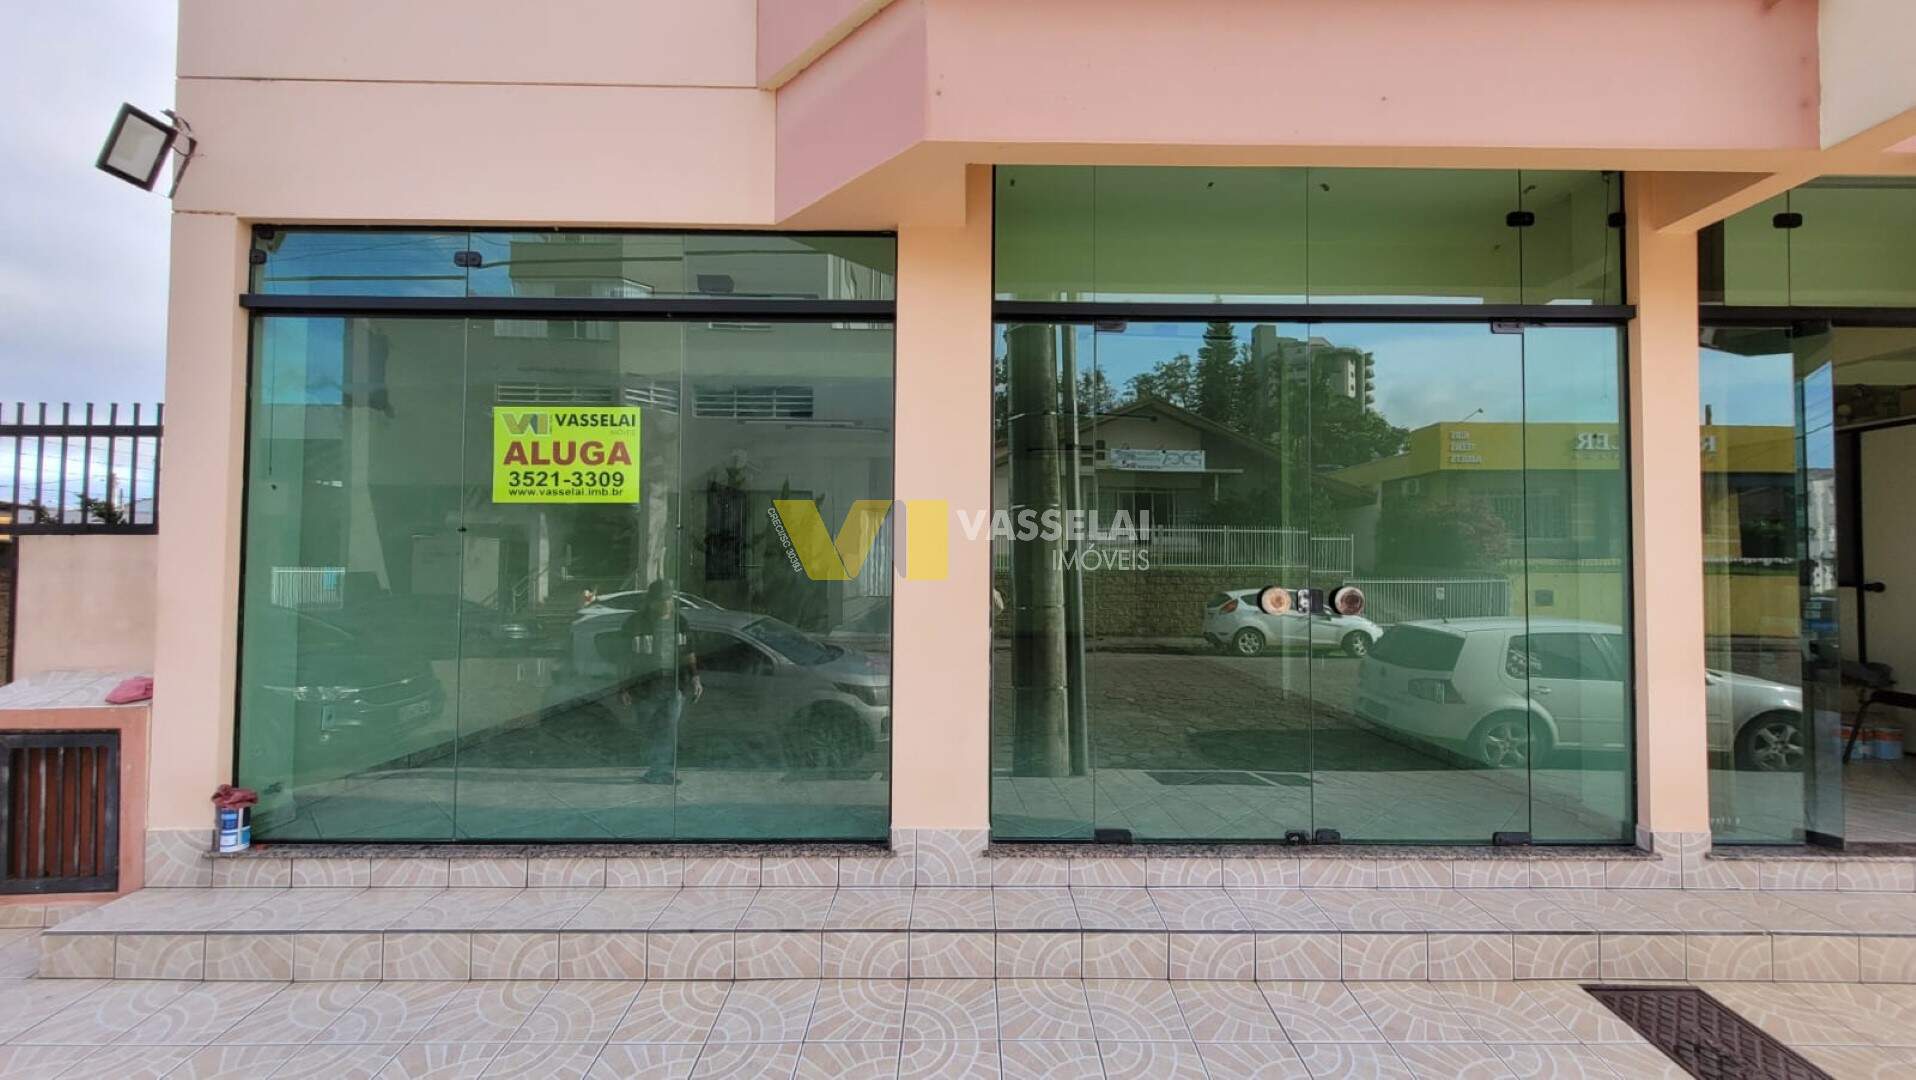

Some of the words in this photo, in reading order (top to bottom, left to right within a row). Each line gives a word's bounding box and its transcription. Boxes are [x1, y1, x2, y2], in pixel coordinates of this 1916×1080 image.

[555, 413, 636, 427] VASSELAI
[503, 441, 632, 466] ALUGA
[508, 471, 625, 487] 3521-3309
[508, 488, 624, 497] www.vasselai.imb.br
